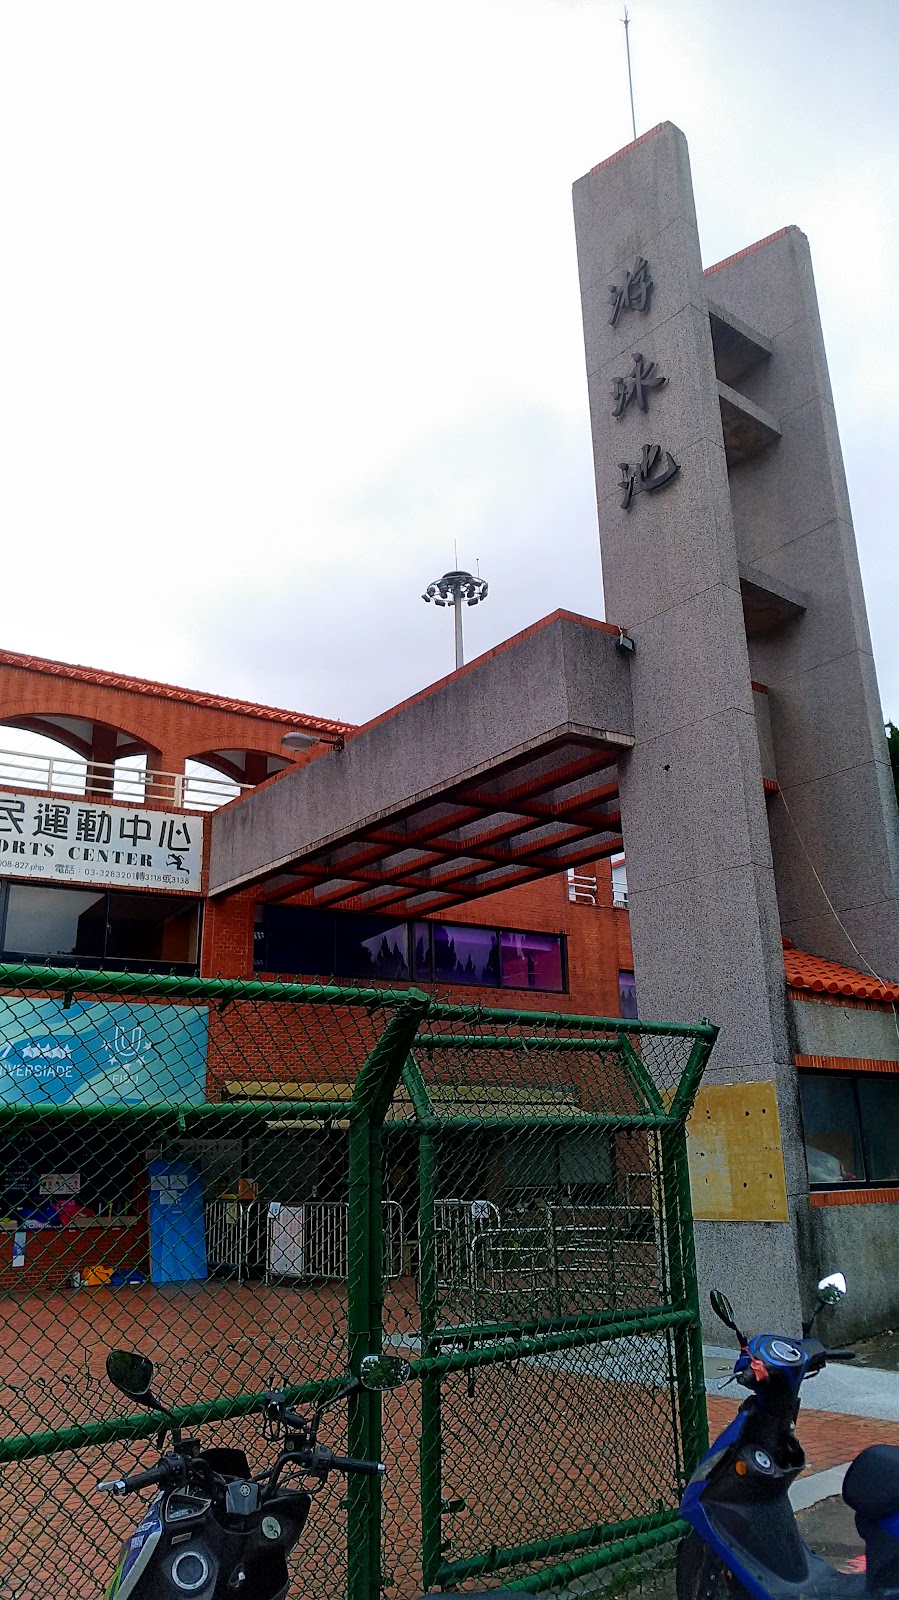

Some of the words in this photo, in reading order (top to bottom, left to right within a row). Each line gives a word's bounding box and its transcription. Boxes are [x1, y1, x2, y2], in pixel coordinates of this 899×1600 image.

[607, 255, 681, 514] 游泳池
[0, 799, 191, 852] 民運動中心
[68, 845, 153, 867] CENTER
[111, 1074, 139, 1085] FISU
